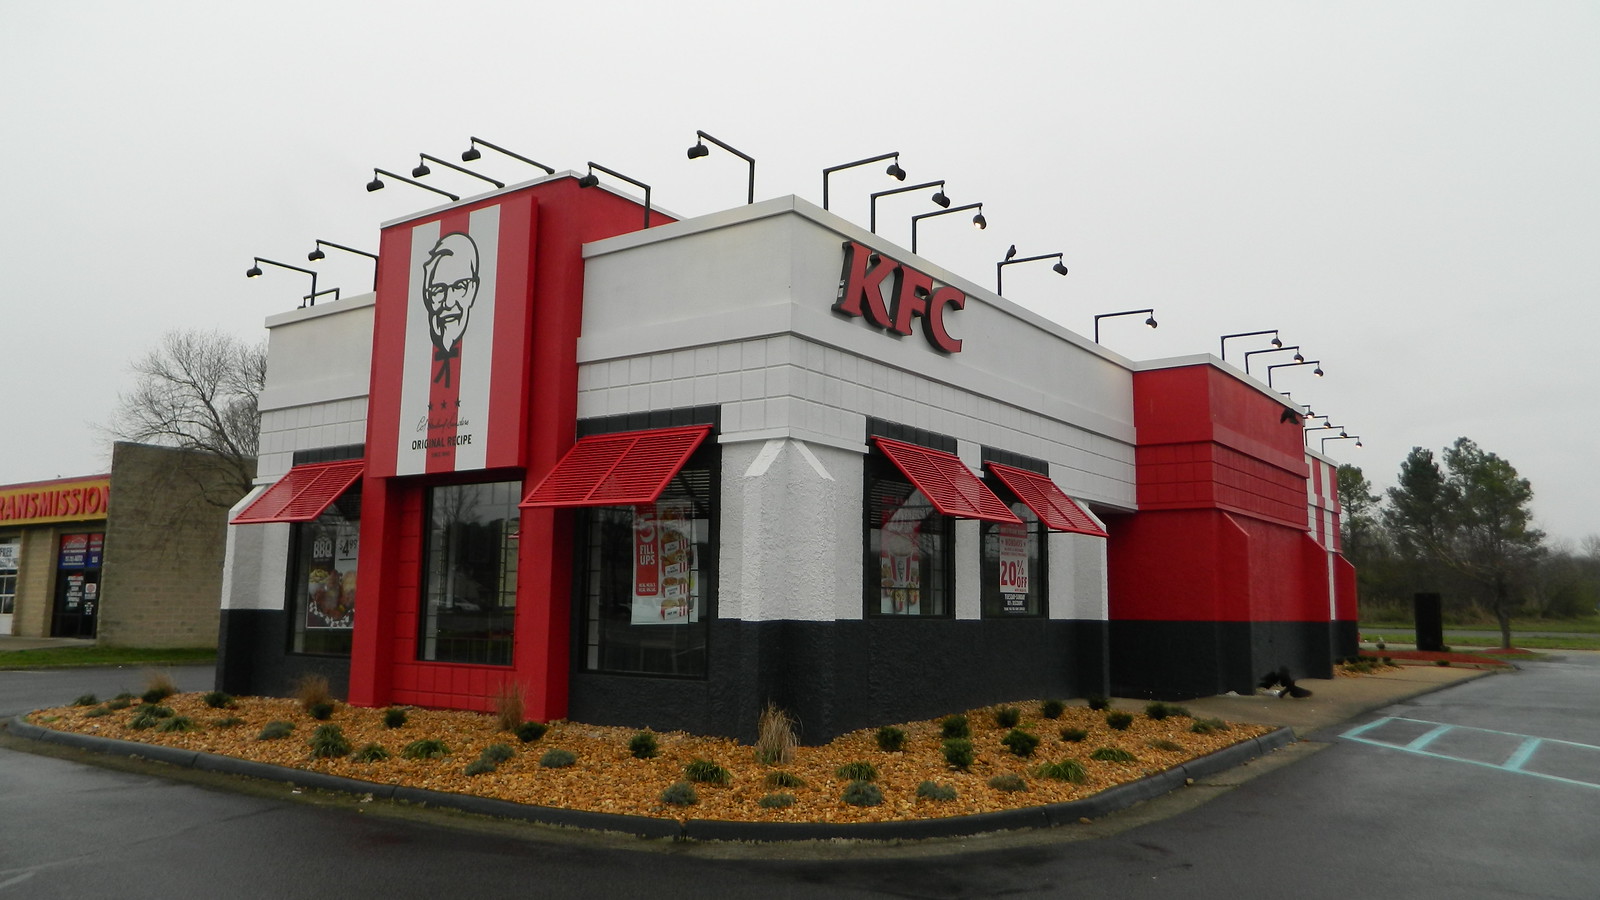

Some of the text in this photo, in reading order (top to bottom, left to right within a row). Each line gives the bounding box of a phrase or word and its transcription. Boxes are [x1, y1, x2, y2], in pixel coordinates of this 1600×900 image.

[831, 240, 966, 353] KFC
[411, 434, 472, 450] ORIGINAL RECIPE
[313, 540, 333, 558] BBQ
[640, 544, 655, 555] FILL
[640, 555, 656, 566] UPS
[1016, 577, 1027, 588] OFF
